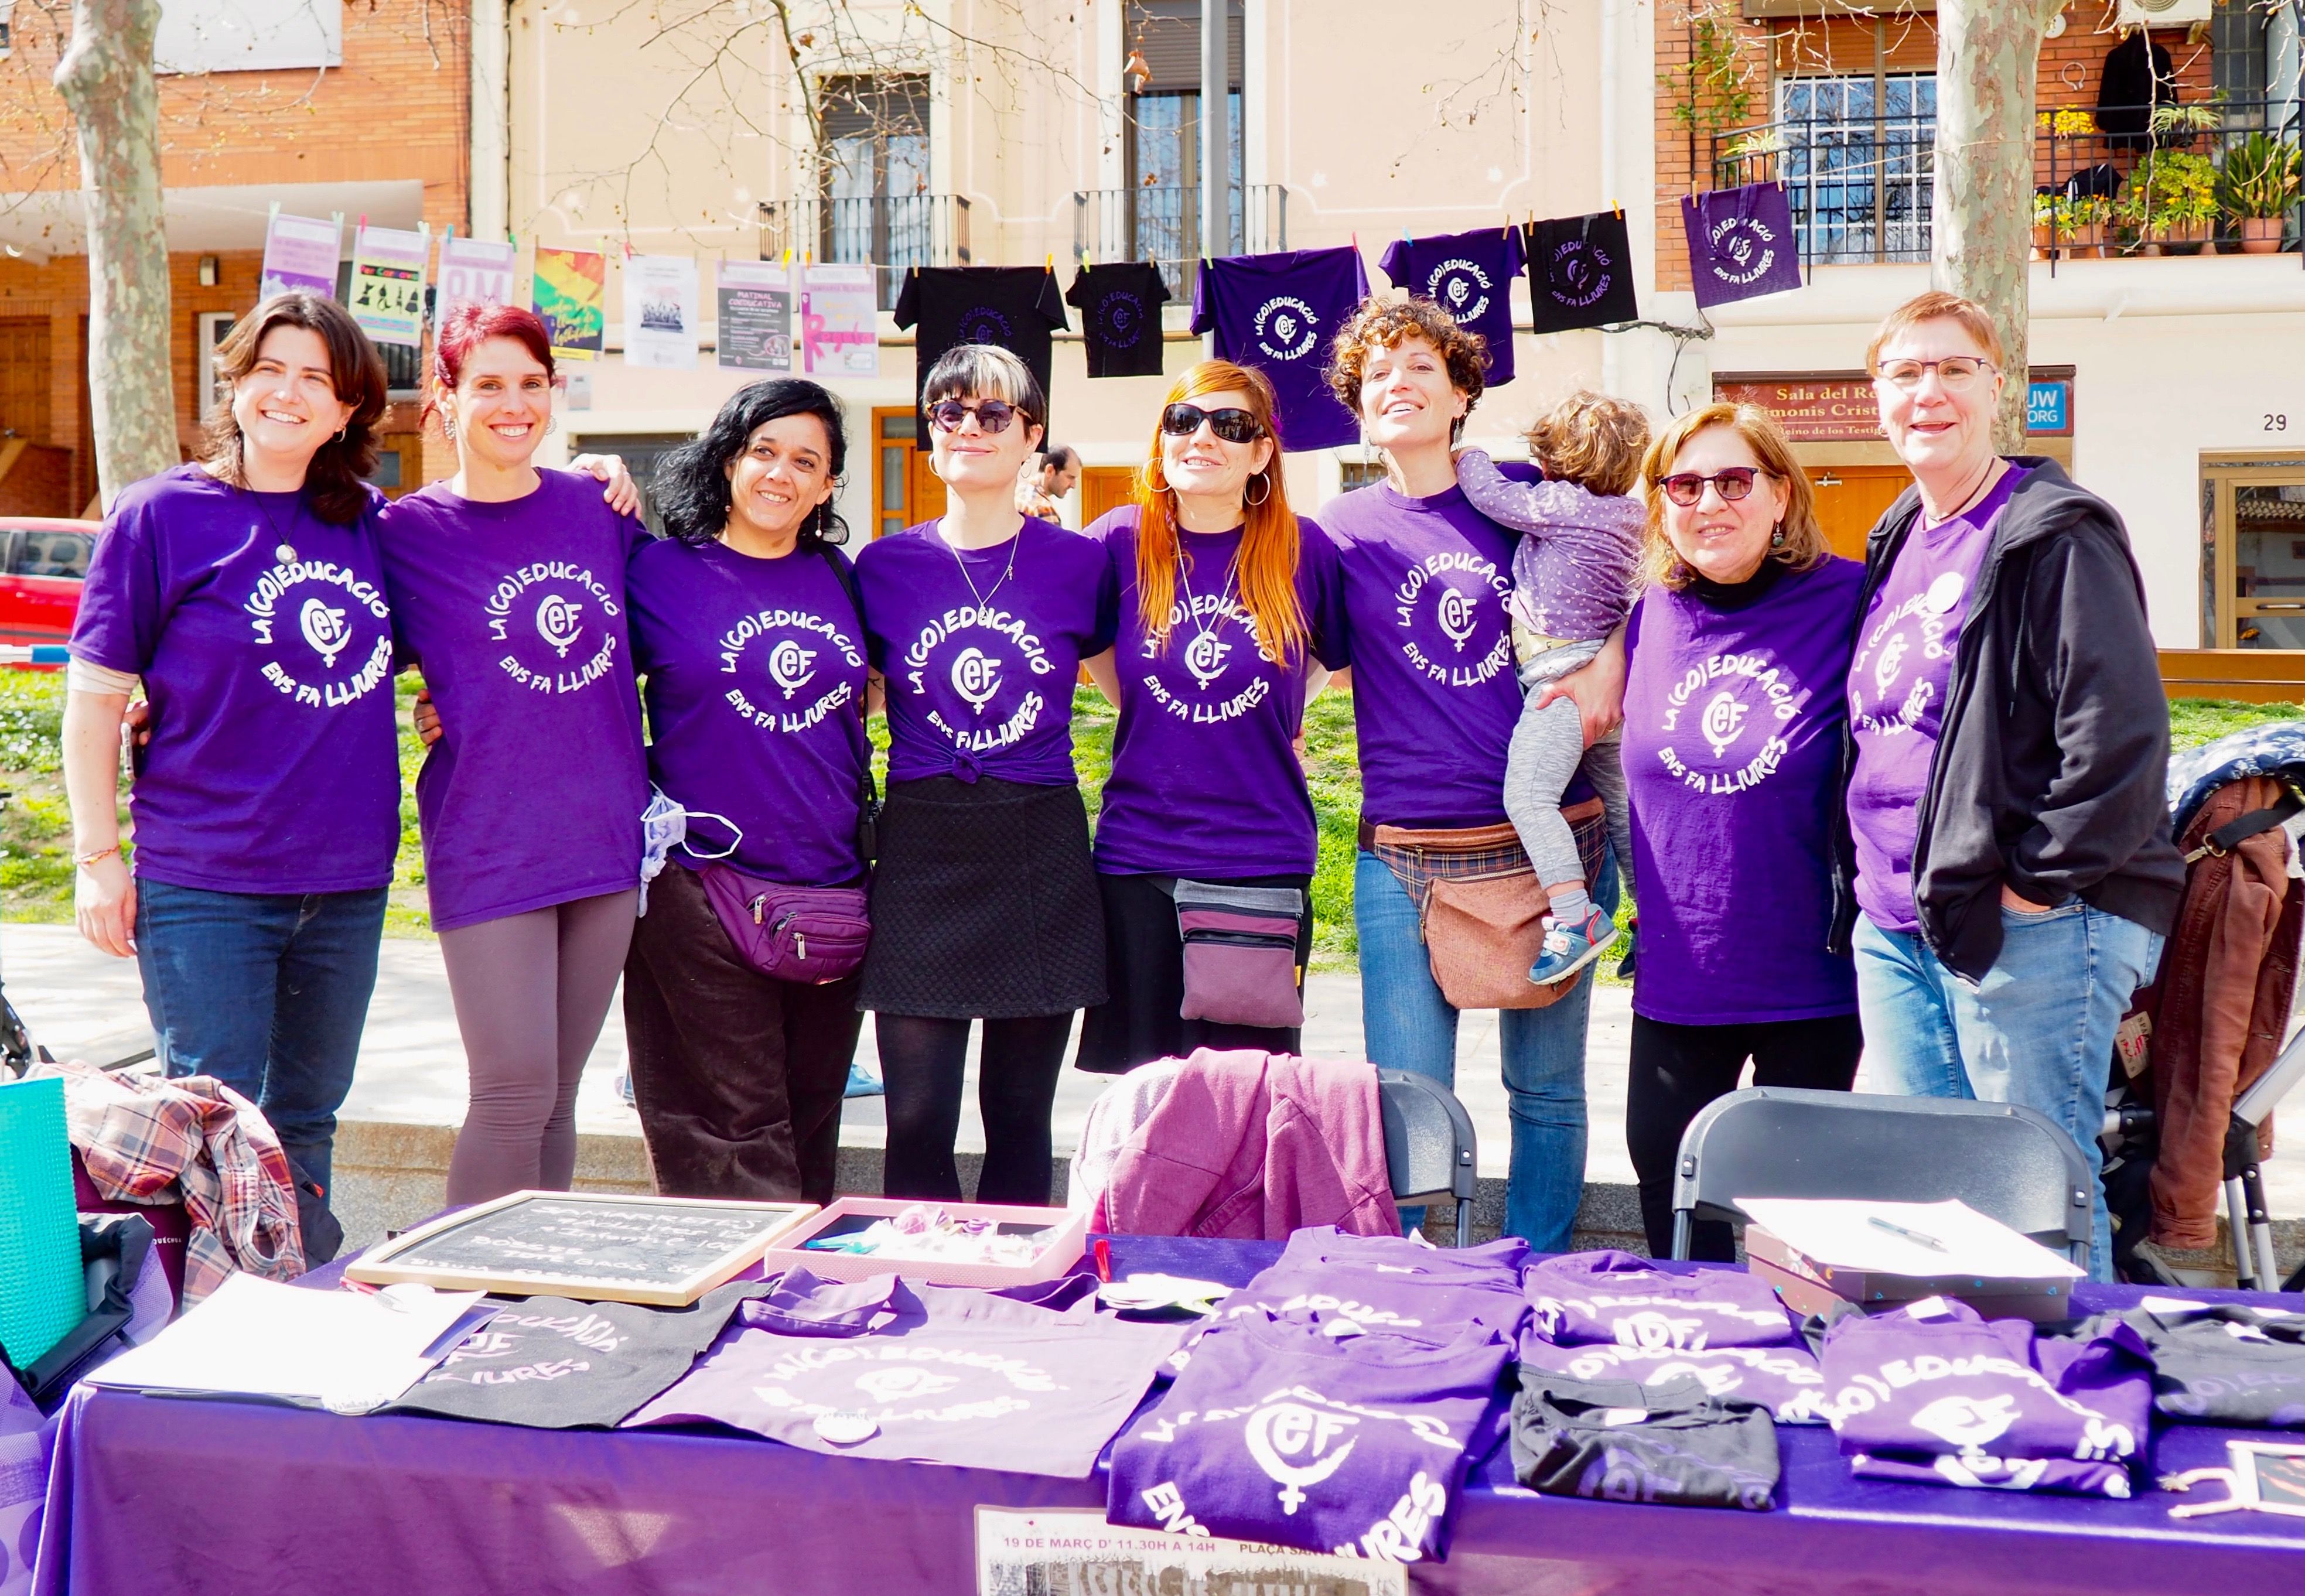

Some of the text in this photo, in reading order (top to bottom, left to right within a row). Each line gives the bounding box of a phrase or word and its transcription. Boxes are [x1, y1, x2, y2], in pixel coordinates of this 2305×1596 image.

[1713, 249, 1774, 285] ENS FA LLIURES
[737, 291, 773, 300] MATINAL
[1552, 274, 1610, 307] ENS FA LLIURES
[728, 298, 783, 309] COEDUCATIVA
[1456, 295, 1490, 324] LLIURES
[1259, 330, 1317, 361] ENS FA LLIURES
[1777, 387, 1877, 401] Sala del Re
[2027, 390, 2057, 408] JW
[1831, 404, 1879, 416] Crist
[2027, 410, 2057, 423] ORG
[2264, 414, 2287, 431] 29
[1828, 426, 1844, 435] los
[1846, 426, 1881, 435] Testig
[1402, 642, 1429, 670] ENS
[1428, 664, 1447, 685] FA
[1452, 630, 1510, 686] LLIURES
[261, 635, 392, 708] ENS FA LLIURES
[499, 655, 531, 683] ENS
[530, 675, 551, 694] FA
[725, 681, 852, 733] ENS FA LLIURES
[1143, 675, 1269, 724] ENS FA LLIURES
[927, 710, 953, 739] ENS
[972, 691, 1043, 751] LLIURES
[1862, 714, 1880, 735] FA
[1658, 736, 1787, 794] ENS FA LLIURES
[503, 1250, 565, 1263] TOTE
[1004, 1537, 1020, 1547] 19
[1025, 1539, 1044, 1548] DE
[1050, 1539, 1092, 1550] MARÇ
[1098, 1540, 1111, 1549] D'
[1118, 1540, 1166, 1550] 11.30H
[1173, 1542, 1181, 1551] A
[1189, 1542, 1215, 1552] 14H
[1239, 1543, 1285, 1556] PLAÇA
